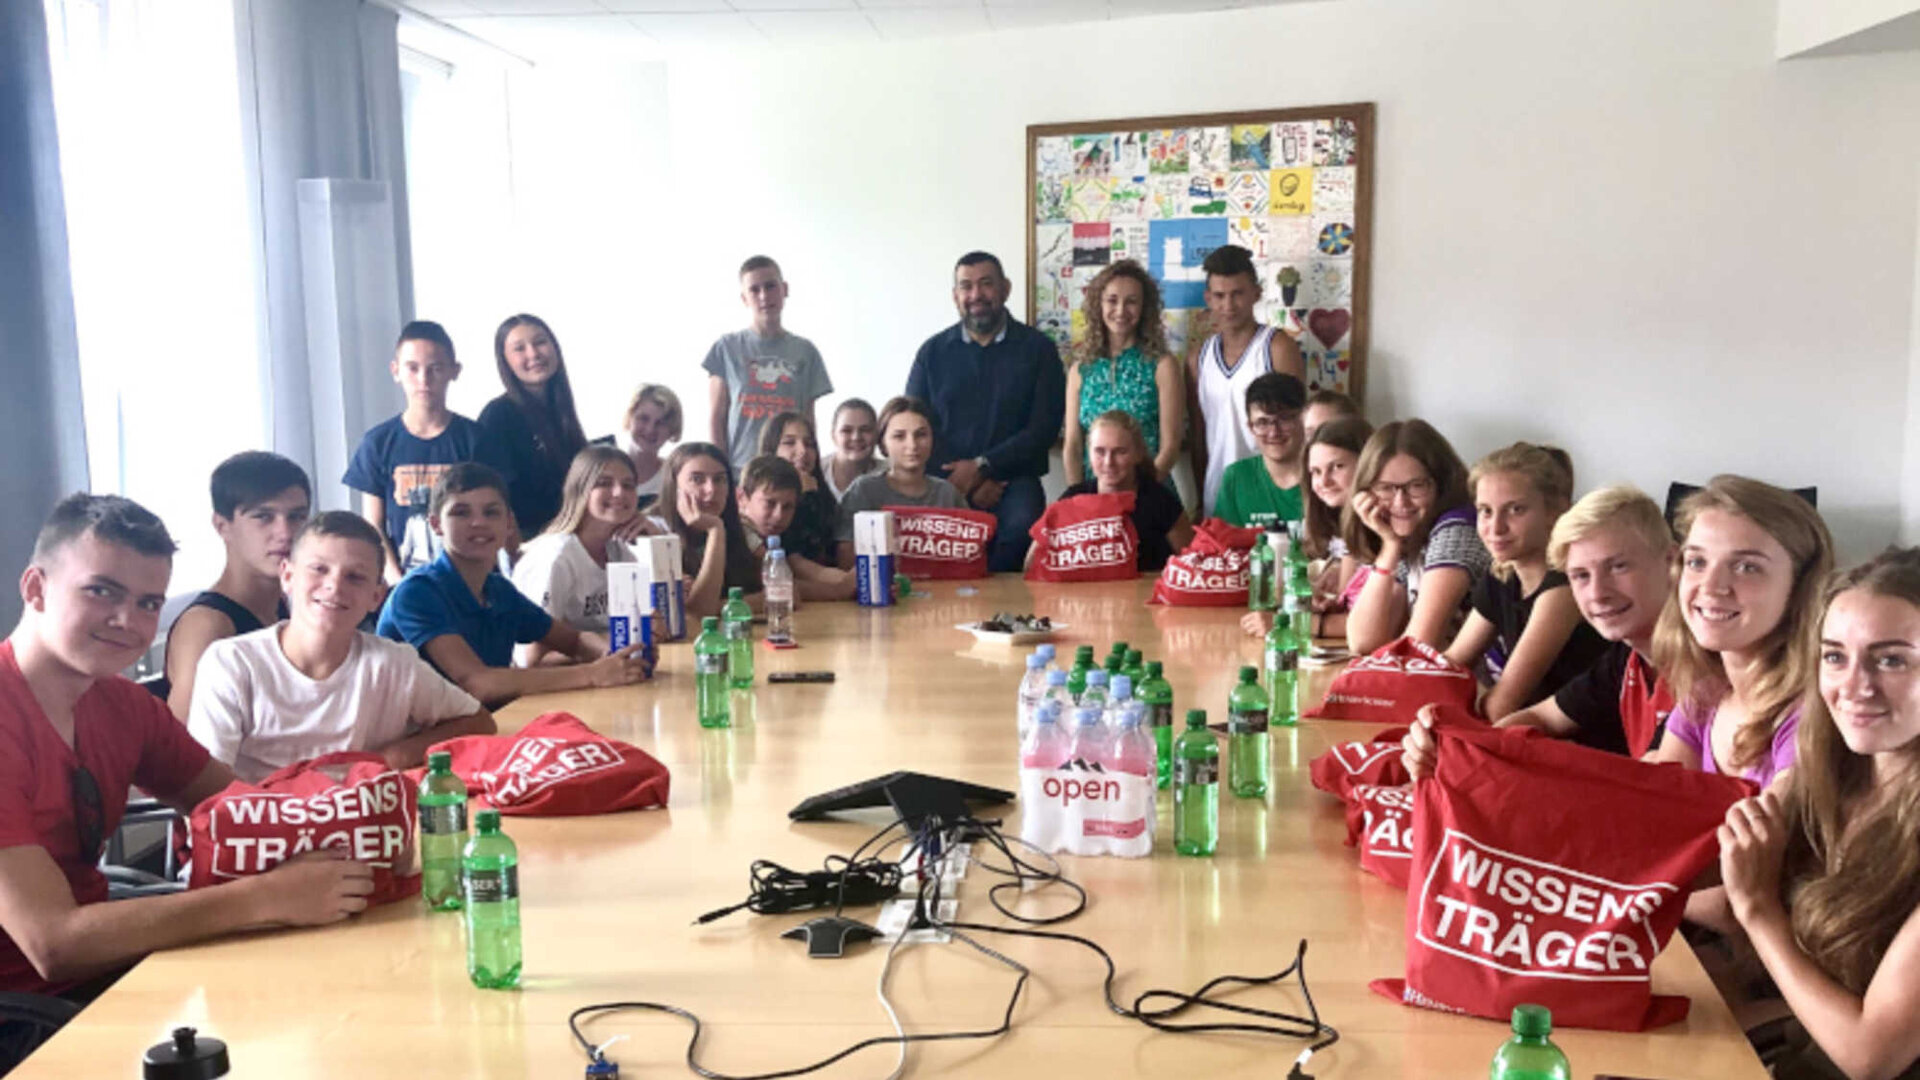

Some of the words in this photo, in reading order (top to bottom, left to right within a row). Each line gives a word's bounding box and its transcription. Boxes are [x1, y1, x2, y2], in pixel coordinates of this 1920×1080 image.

[226, 781, 398, 825] WISSENS
[1043, 778, 1121, 807] open
[1450, 844, 1663, 925] WISSENS
[1433, 894, 1647, 972] TRÄGER
